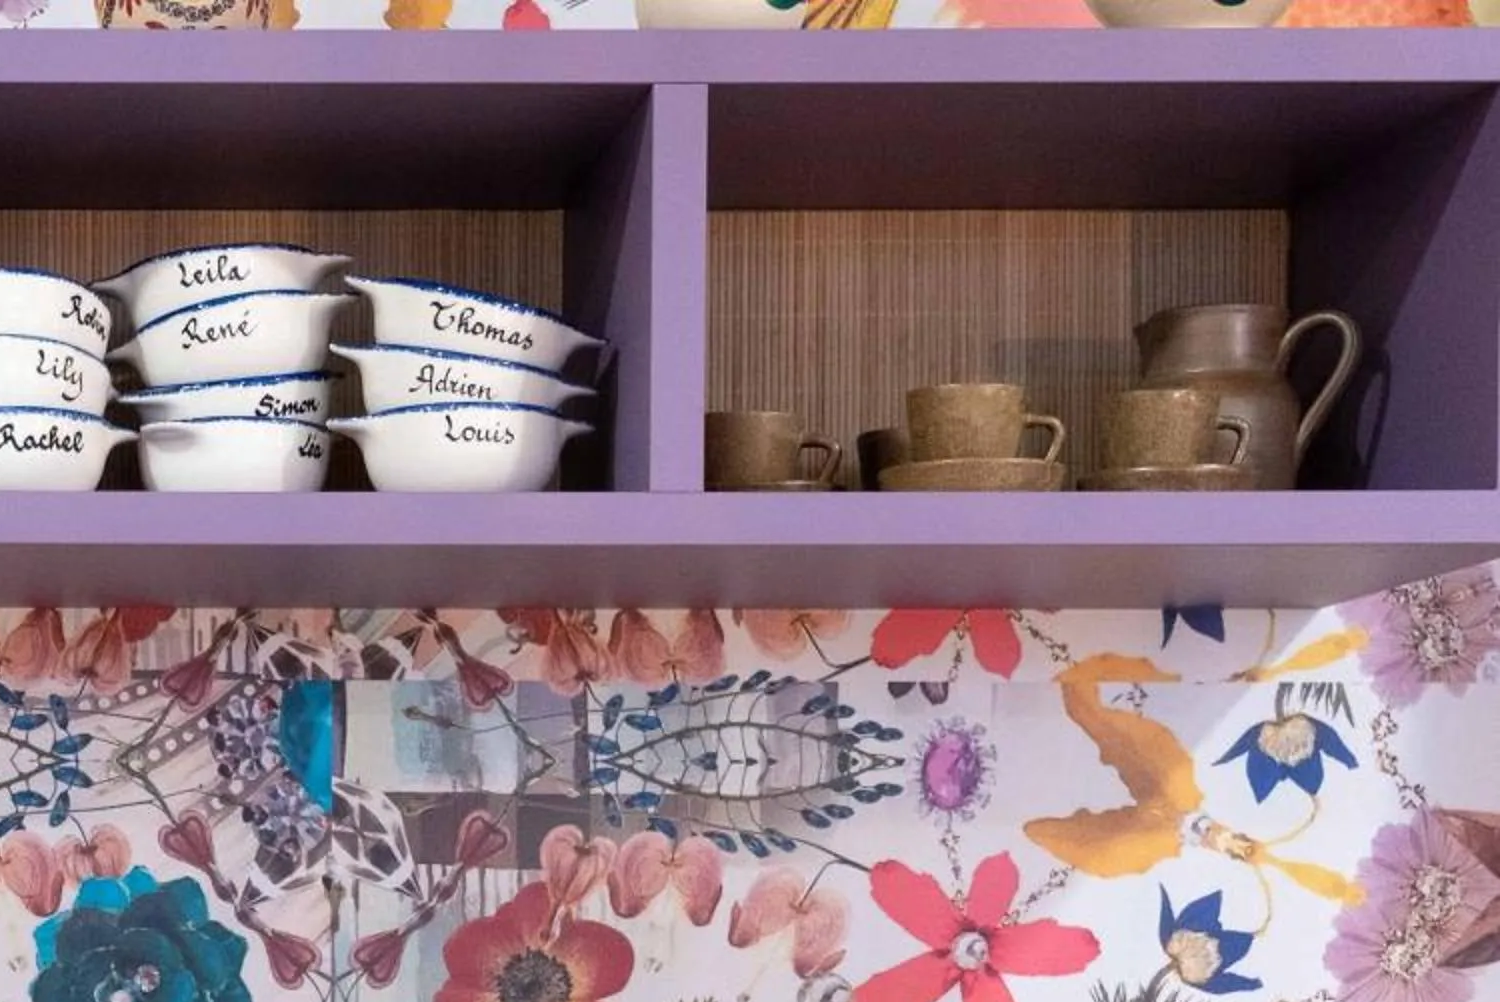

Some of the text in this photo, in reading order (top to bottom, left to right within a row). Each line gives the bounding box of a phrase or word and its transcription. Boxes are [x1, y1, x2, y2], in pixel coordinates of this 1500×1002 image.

[179, 256, 248, 286] Leila
[182, 311, 259, 349] René
[430, 301, 534, 350] Thomas
[36, 350, 84, 401] Lily
[409, 363, 494, 400] Adrien
[255, 393, 318, 417] Simon
[444, 415, 516, 445] Louis
